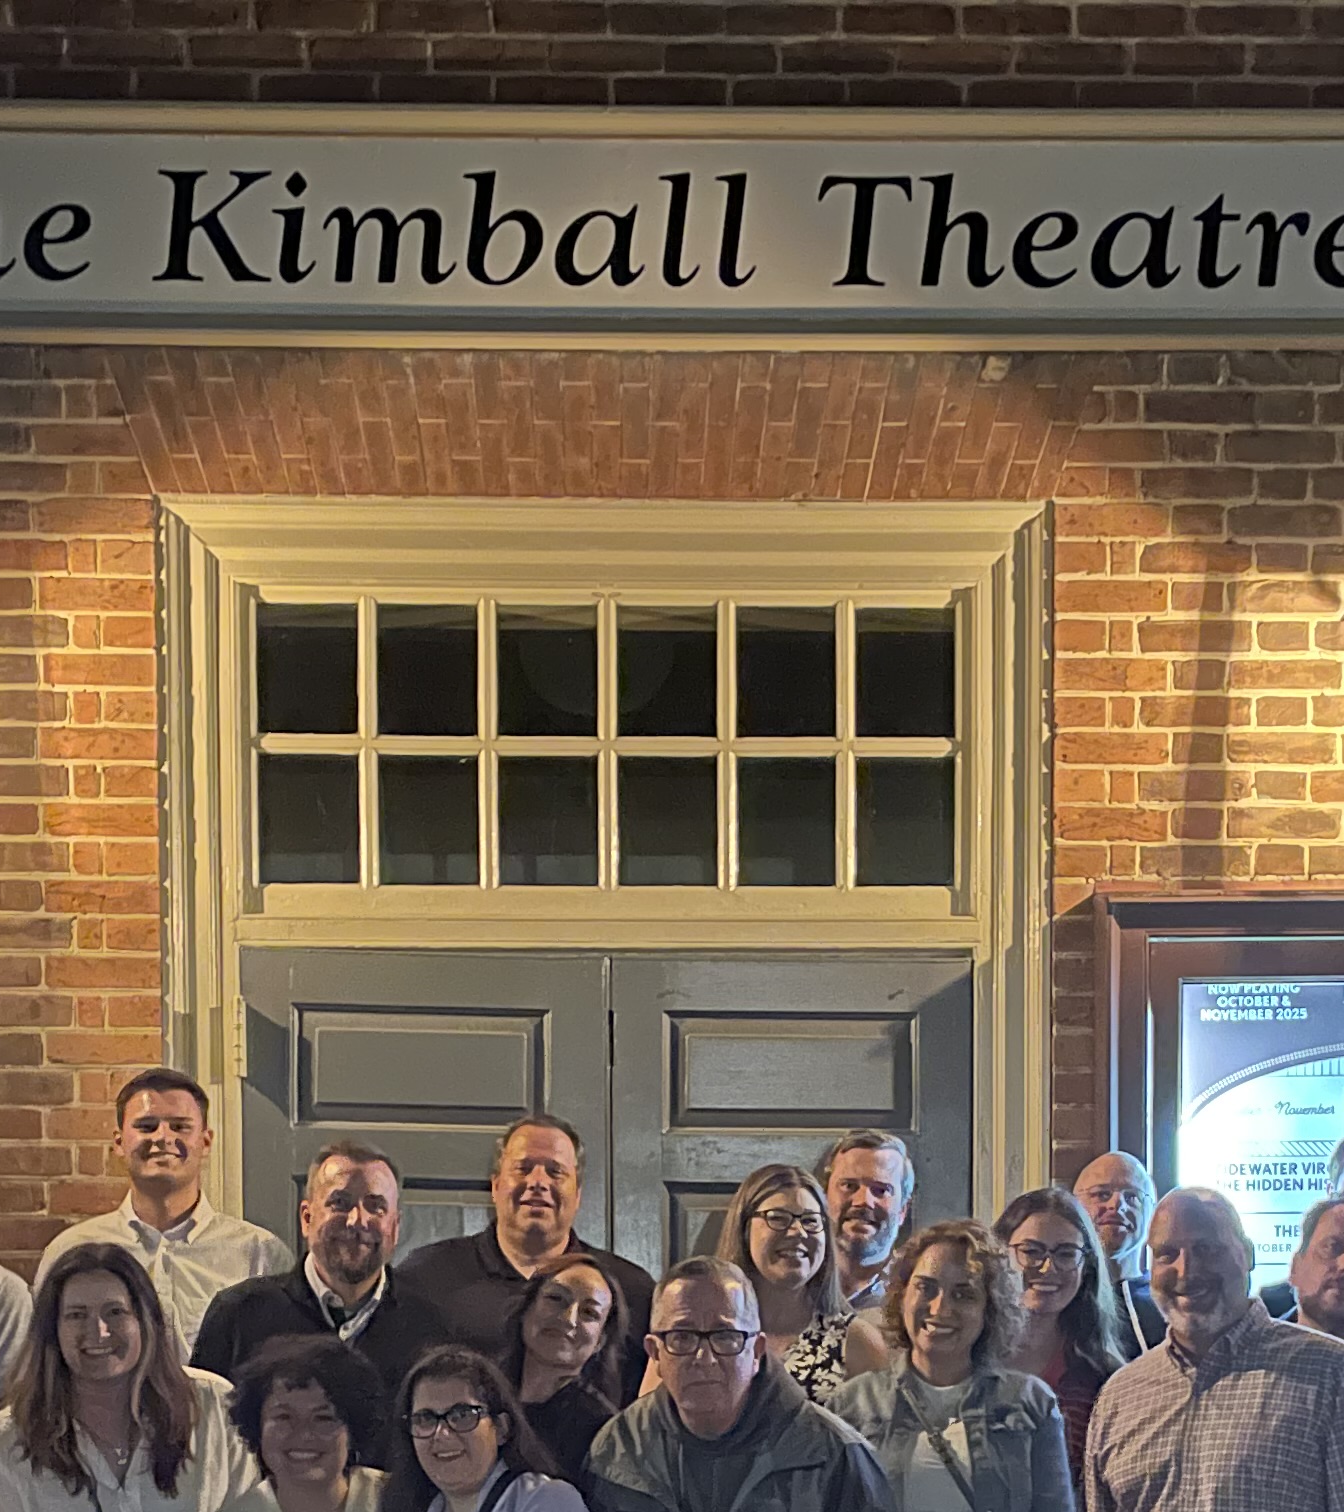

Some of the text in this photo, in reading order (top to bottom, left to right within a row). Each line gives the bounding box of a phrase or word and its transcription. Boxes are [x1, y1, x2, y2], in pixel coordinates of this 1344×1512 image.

[153, 170, 757, 288] Kimball
[1207, 983, 1301, 995] NOW PLAYING
[1216, 996, 1291, 1007] OCTOBER &
[1200, 1008, 1308, 1021] NOVEMBER 2025
[1246, 1178, 1303, 1191] HIDDEN
